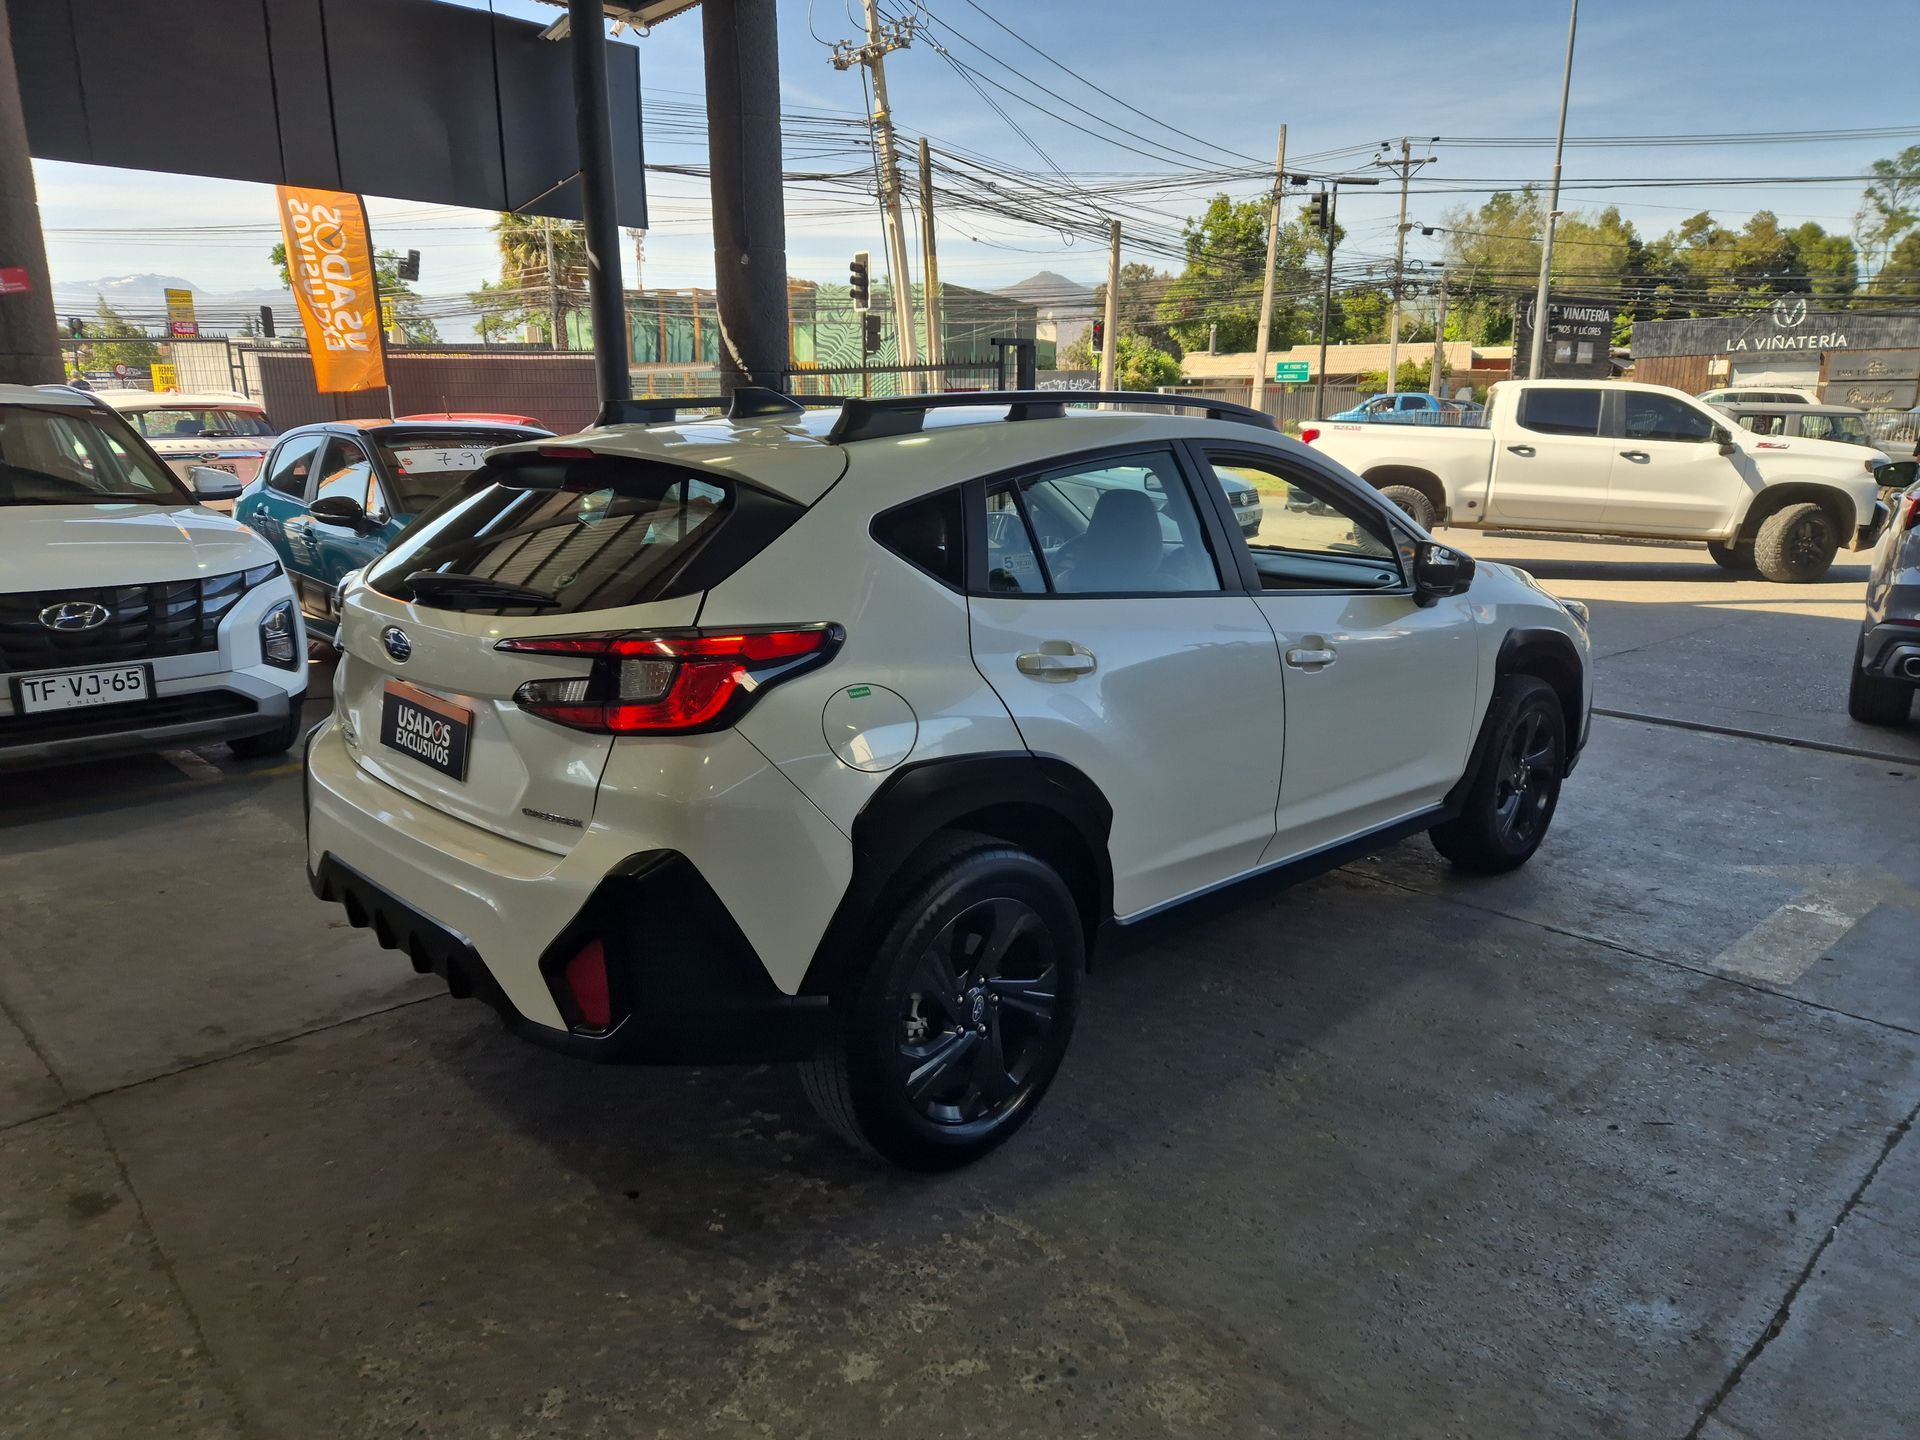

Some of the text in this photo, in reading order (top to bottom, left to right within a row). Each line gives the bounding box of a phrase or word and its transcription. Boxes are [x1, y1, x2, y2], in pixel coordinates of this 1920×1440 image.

[1573, 326, 1578, 334] Y
[1578, 326, 1602, 336] LICORES
[1726, 332, 1848, 351] LA VIÑATERÍA
[402, 457, 413, 466] $
[66, 697, 107, 706] CHILE
[397, 704, 451, 747] USADOS
[395, 727, 449, 766] EXCLUSIVOS
